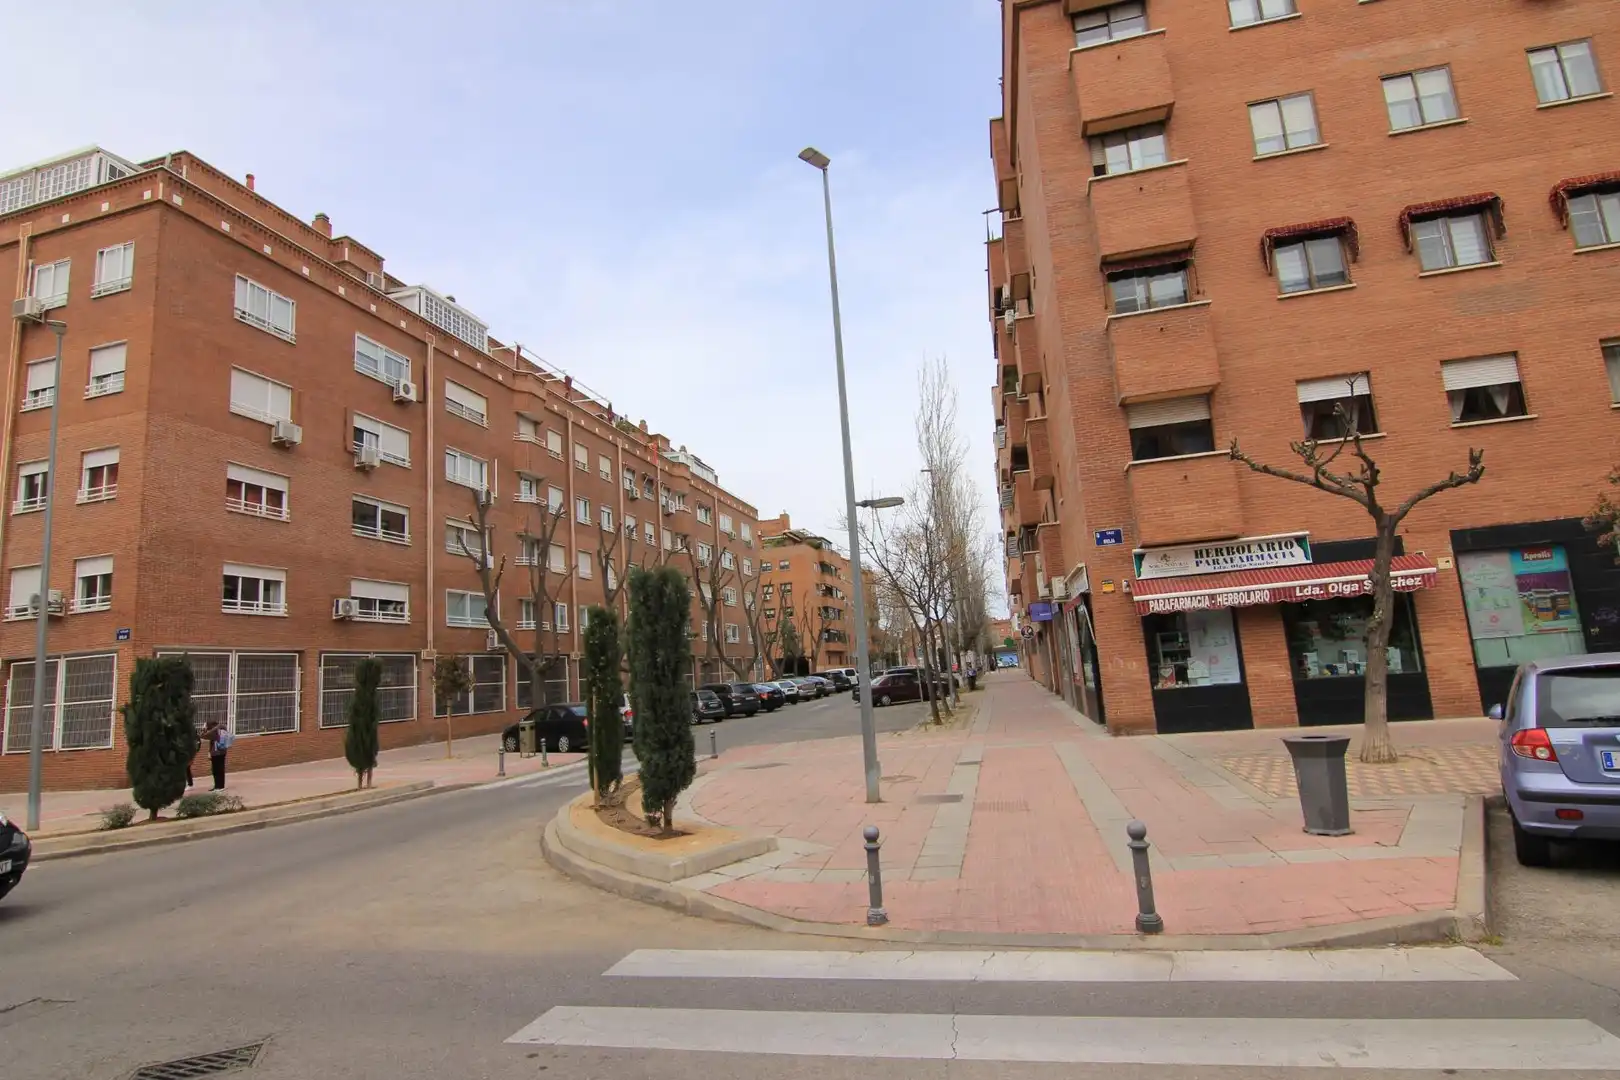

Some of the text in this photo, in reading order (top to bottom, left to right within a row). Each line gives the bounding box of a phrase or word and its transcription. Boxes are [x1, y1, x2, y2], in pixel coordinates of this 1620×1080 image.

[1194, 540, 1294, 559] HERBOLARIO
[1195, 551, 1296, 567] PARAFARMACIA
[1295, 577, 1422, 597] Lda. Olga Schez
[1149, 595, 1210, 612] PARAFARMACIA
[1216, 590, 1270, 606] HERBOLARIO
